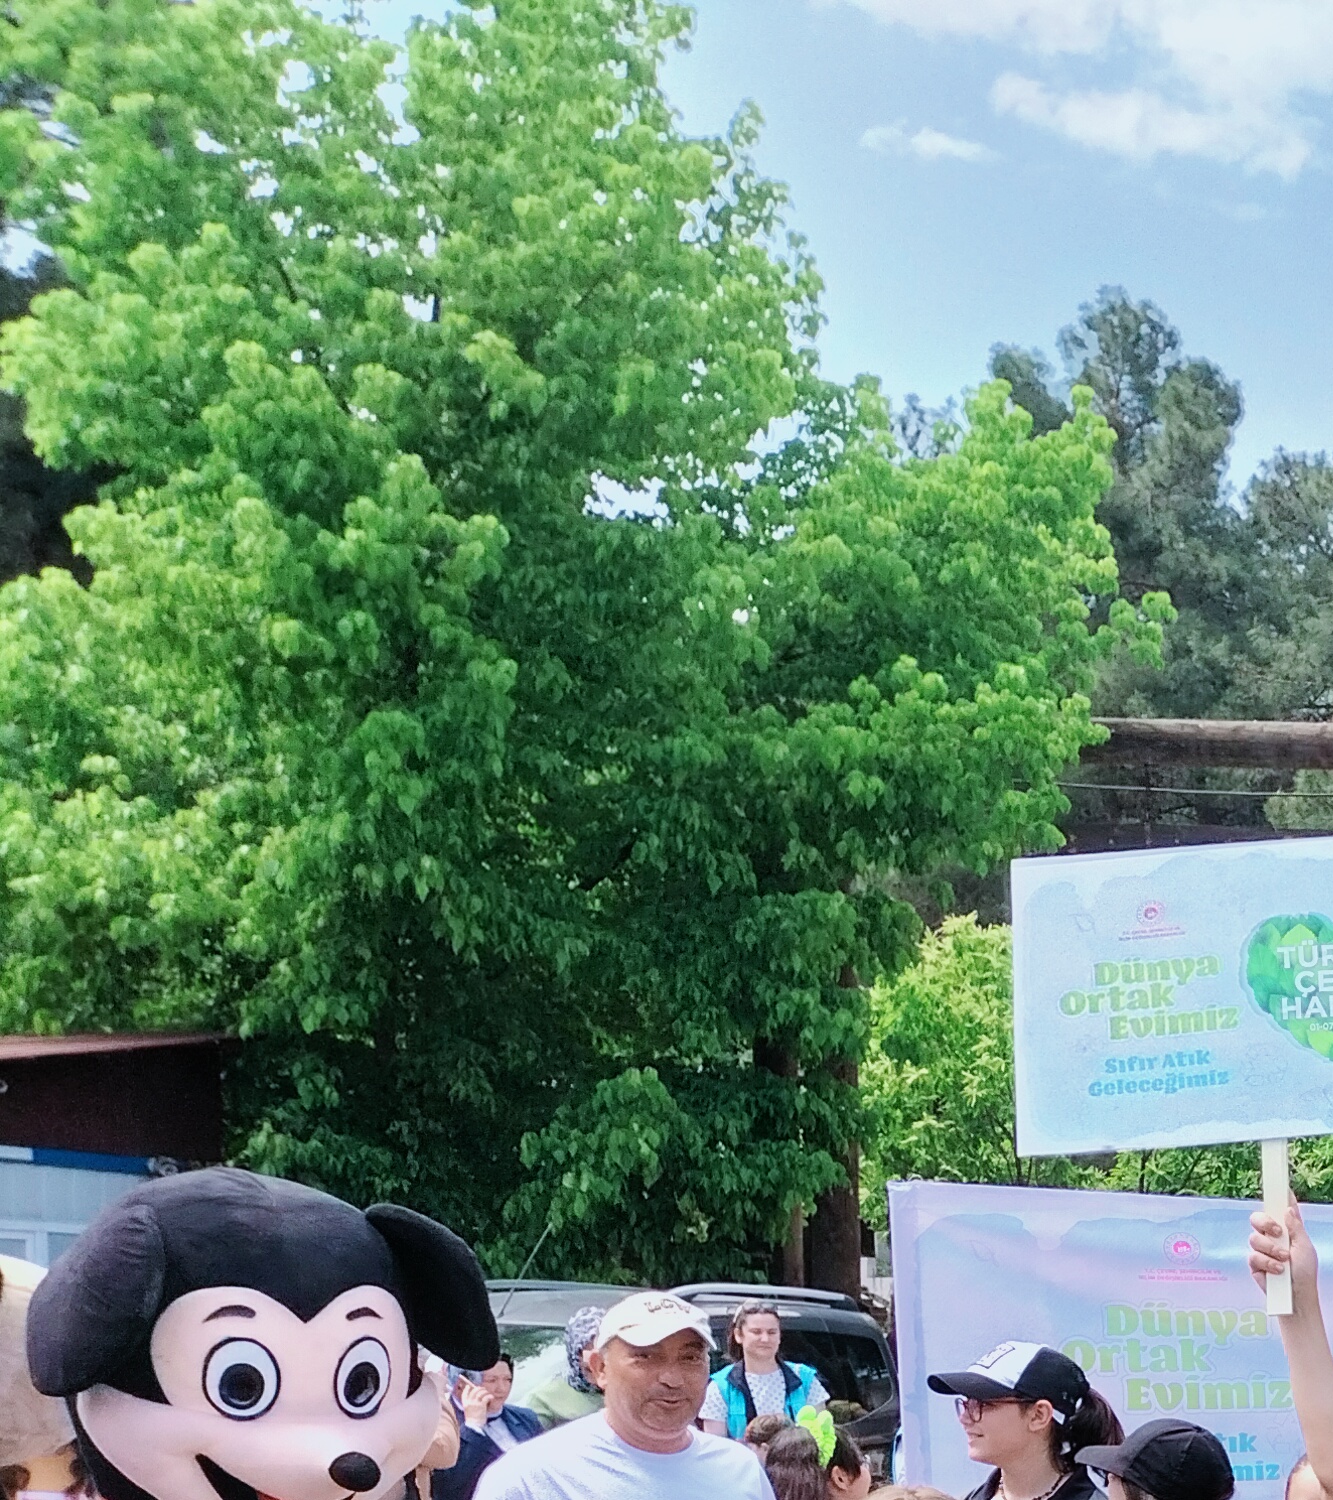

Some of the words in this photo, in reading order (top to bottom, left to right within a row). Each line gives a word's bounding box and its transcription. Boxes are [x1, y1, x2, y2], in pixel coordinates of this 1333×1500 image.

[1094, 955, 1219, 986] Dünya
[1060, 982, 1174, 1016] Ortak
[1109, 1004, 1239, 1040] Evimiz
[1310, 1021, 1333, 1031] 01-07
[1105, 1055, 1158, 1074] Sıfır
[1162, 1049, 1210, 1069] Atık
[1089, 1069, 1230, 1097] Geleceğimiz
[1106, 1302, 1268, 1345] Dünya
[1061, 1338, 1212, 1373] Ortak
[1127, 1375, 1293, 1410] Evimiz
